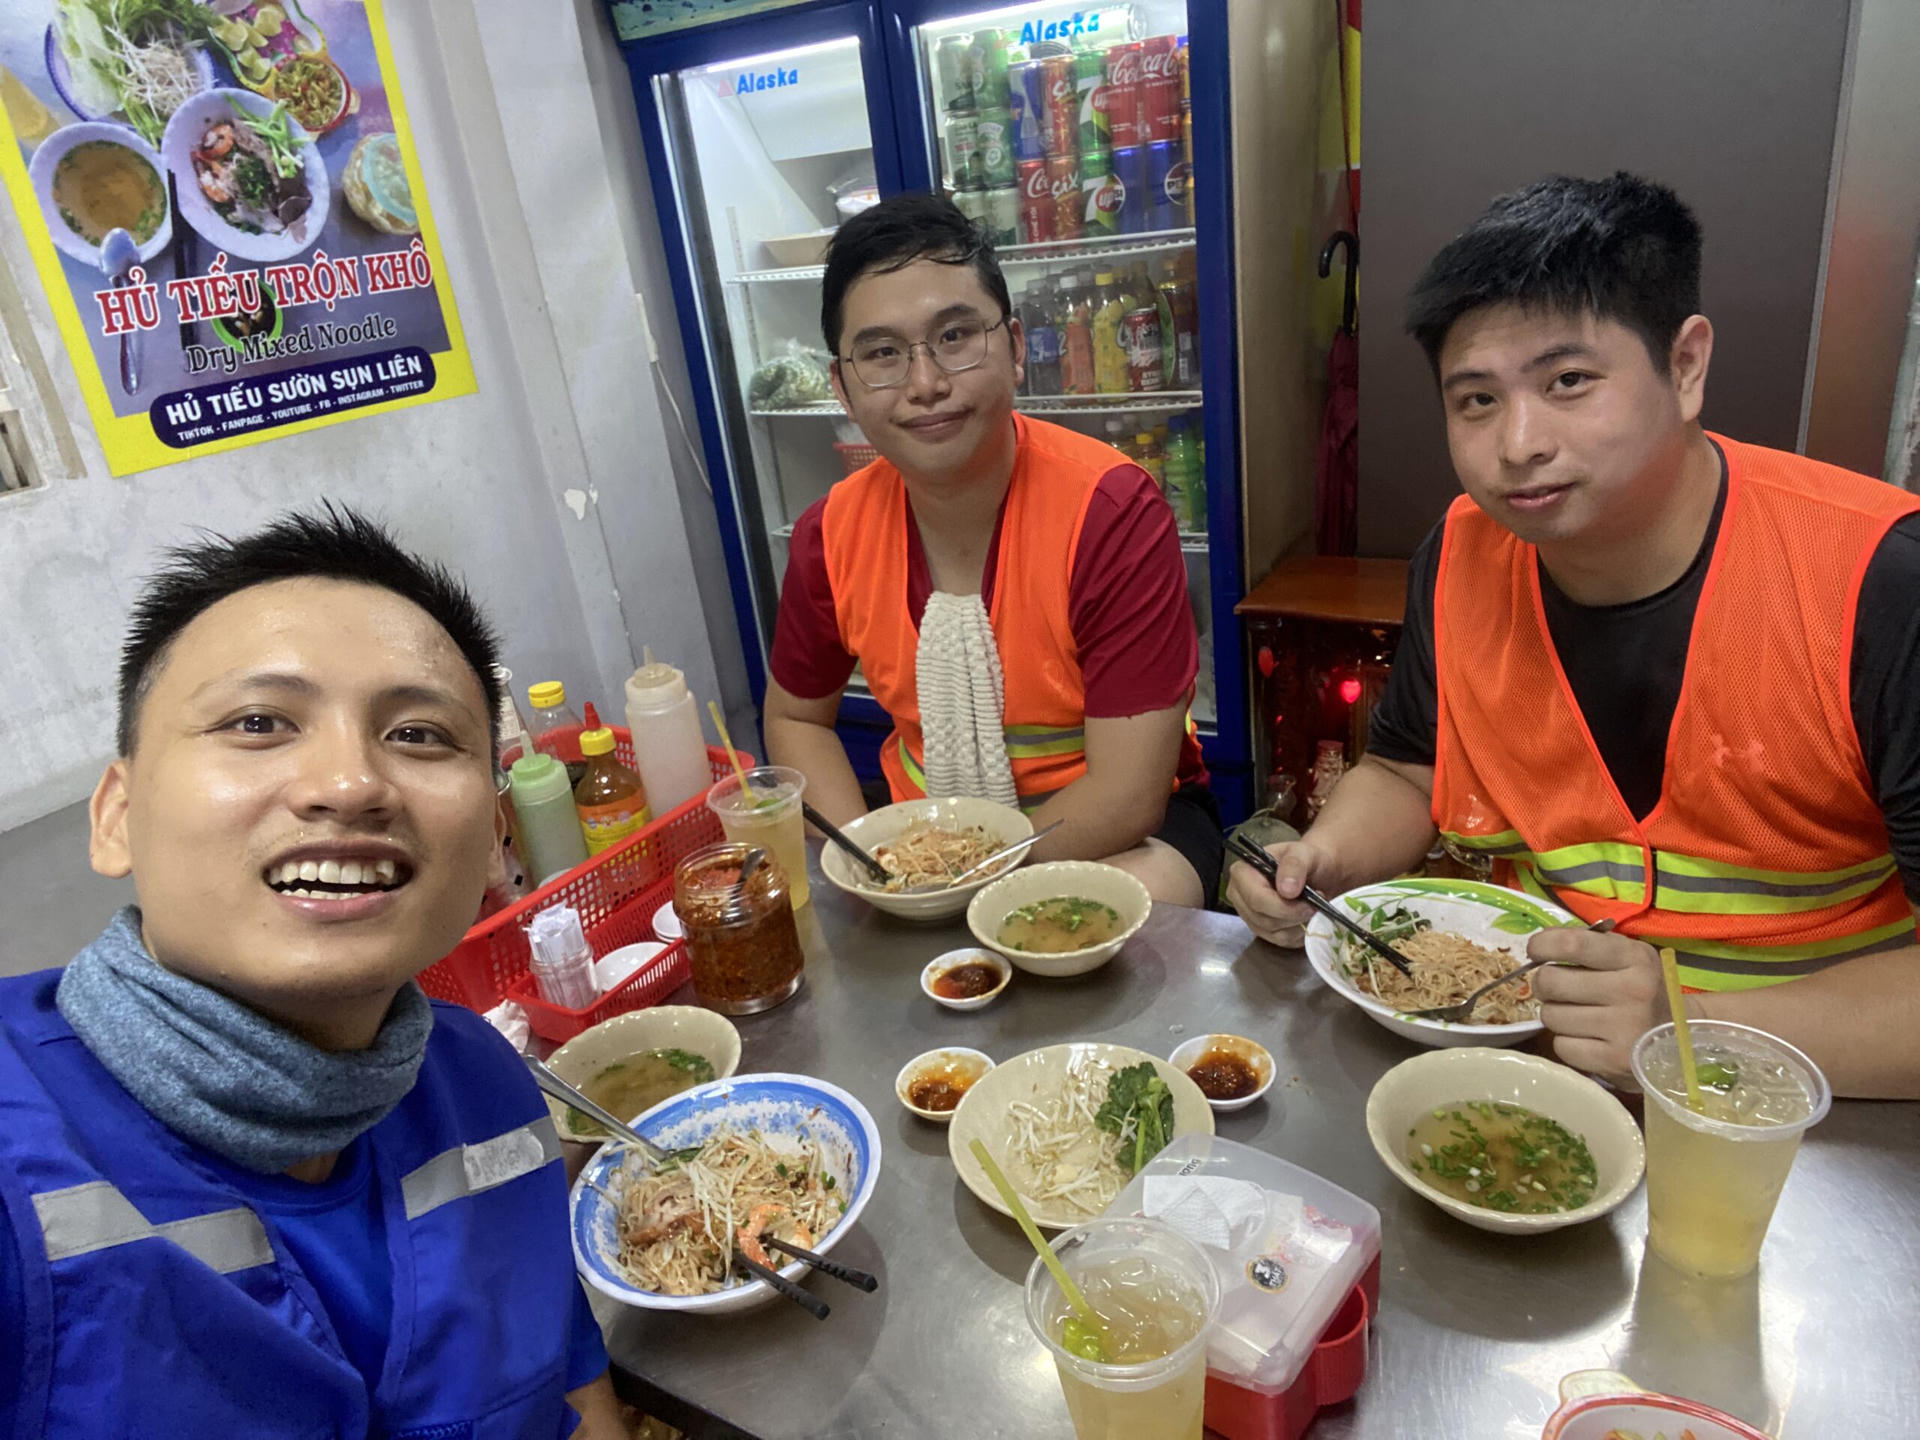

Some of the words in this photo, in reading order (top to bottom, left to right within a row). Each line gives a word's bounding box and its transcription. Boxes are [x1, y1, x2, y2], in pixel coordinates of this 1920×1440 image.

[1019, 12, 1099, 46] Alaska
[737, 67, 798, 94] Alaska
[95, 266, 161, 336] HỦ
[167, 252, 262, 323] TIẾU
[264, 248, 361, 311] TRỘN
[363, 238, 433, 294] KHÔ
[186, 344, 238, 374] Dry
[241, 325, 316, 363] Mixed
[316, 312, 398, 350] Noodle
[165, 393, 201, 425] HỦ
[206, 382, 263, 415] TIẾU
[268, 373, 328, 404] SƯỜN
[330, 364, 374, 390] SỤN
[376, 353, 422, 380] LIÊN
[177, 425, 215, 441] TIKTOK
[221, 414, 264, 431] FANPAGE
[271, 403, 312, 420] YOUTUBE
[318, 399, 331, 410] FB
[337, 388, 385, 405] INSTAGRAM
[390, 380, 425, 394] TWITTER
